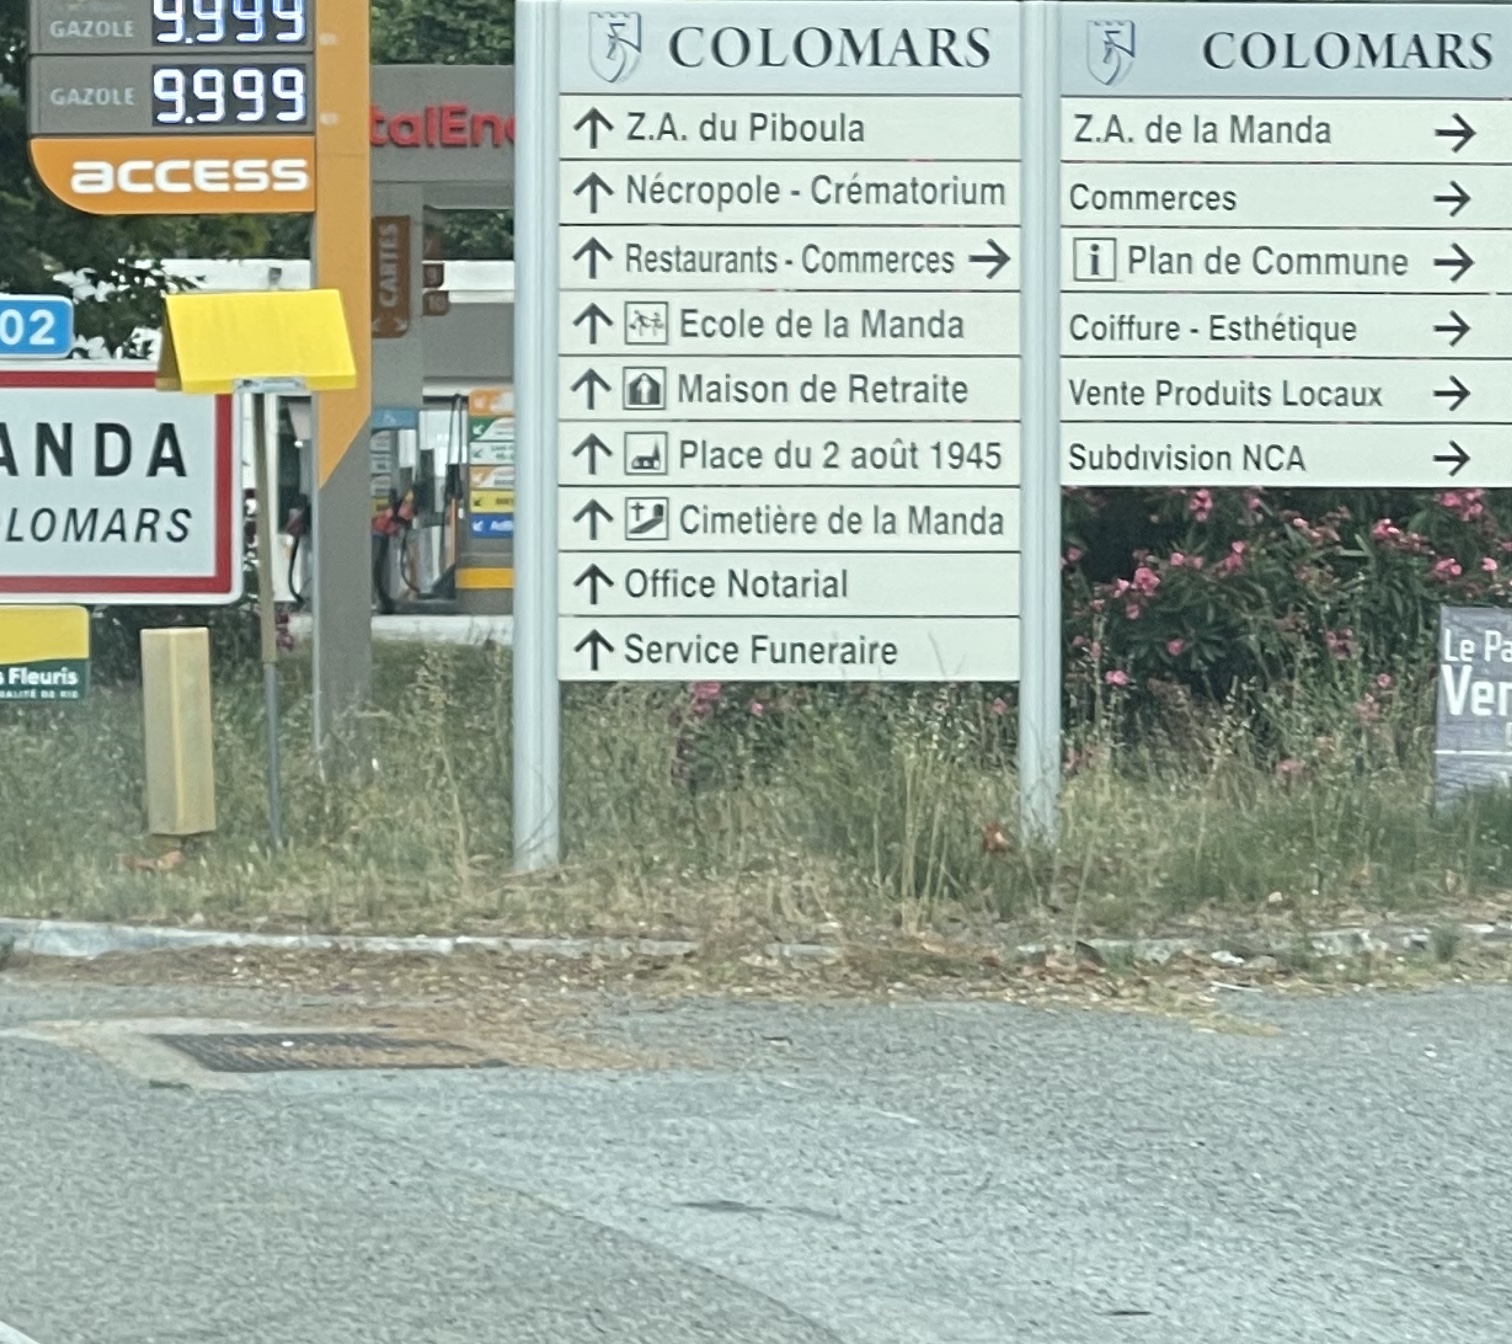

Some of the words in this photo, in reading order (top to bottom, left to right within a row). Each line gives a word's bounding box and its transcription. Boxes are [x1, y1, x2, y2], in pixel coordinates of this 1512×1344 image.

[49, 20, 135, 38] GAZOLE
[669, 26, 991, 68] COLOMARS
[1202, 32, 1494, 70] COLOMARS
[49, 88, 135, 106] GAZOLE
[153, 68, 306, 124] 9.999
[626, 112, 688, 142] Z.A.
[699, 112, 737, 142] du
[749, 112, 865, 142] Piboula
[1073, 114, 1134, 144] Z.A.
[1145, 114, 1182, 144] de
[1193, 114, 1218, 144] la
[1229, 114, 1332, 144] Manda
[626, 172, 780, 212] Nécropole
[811, 172, 1006, 206] Crématorium
[1069, 183, 1237, 211] Commerces
[625, 243, 778, 274] Restaurants
[801, 243, 955, 274] Commerces
[1128, 245, 1194, 276] Plan
[1204, 246, 1241, 276] de
[1251, 246, 1409, 276] Commune
[681, 309, 765, 339] Ecole
[776, 309, 812, 339] de
[824, 309, 849, 339] la
[860, 309, 965, 339] Manda
[1069, 313, 1181, 342] Coiffure
[1209, 311, 1358, 348] Esthétique
[678, 373, 789, 404] Maison
[800, 373, 837, 404] de
[848, 373, 968, 404] Retraite
[1068, 378, 1145, 406] Vente
[1155, 379, 1272, 407] Produits
[1282, 380, 1384, 407] Locaux
[679, 439, 764, 470] Place
[774, 440, 812, 470] du
[823, 441, 839, 470] 2
[850, 436, 919, 470] août
[931, 441, 1002, 470] 1945
[1068, 443, 1232, 471] Subdivision
[1242, 444, 1307, 472] NCA
[679, 504, 818, 536] Cimetière
[827, 505, 863, 536] de
[873, 505, 897, 536] la
[907, 505, 1004, 536] Manda
[624, 568, 716, 598] Office
[727, 568, 849, 598] Notarial
[624, 633, 739, 665] Service
[751, 633, 898, 665] Funeraire
[1445, 629, 1475, 662] Le
[8, 667, 79, 685] Fleuris
